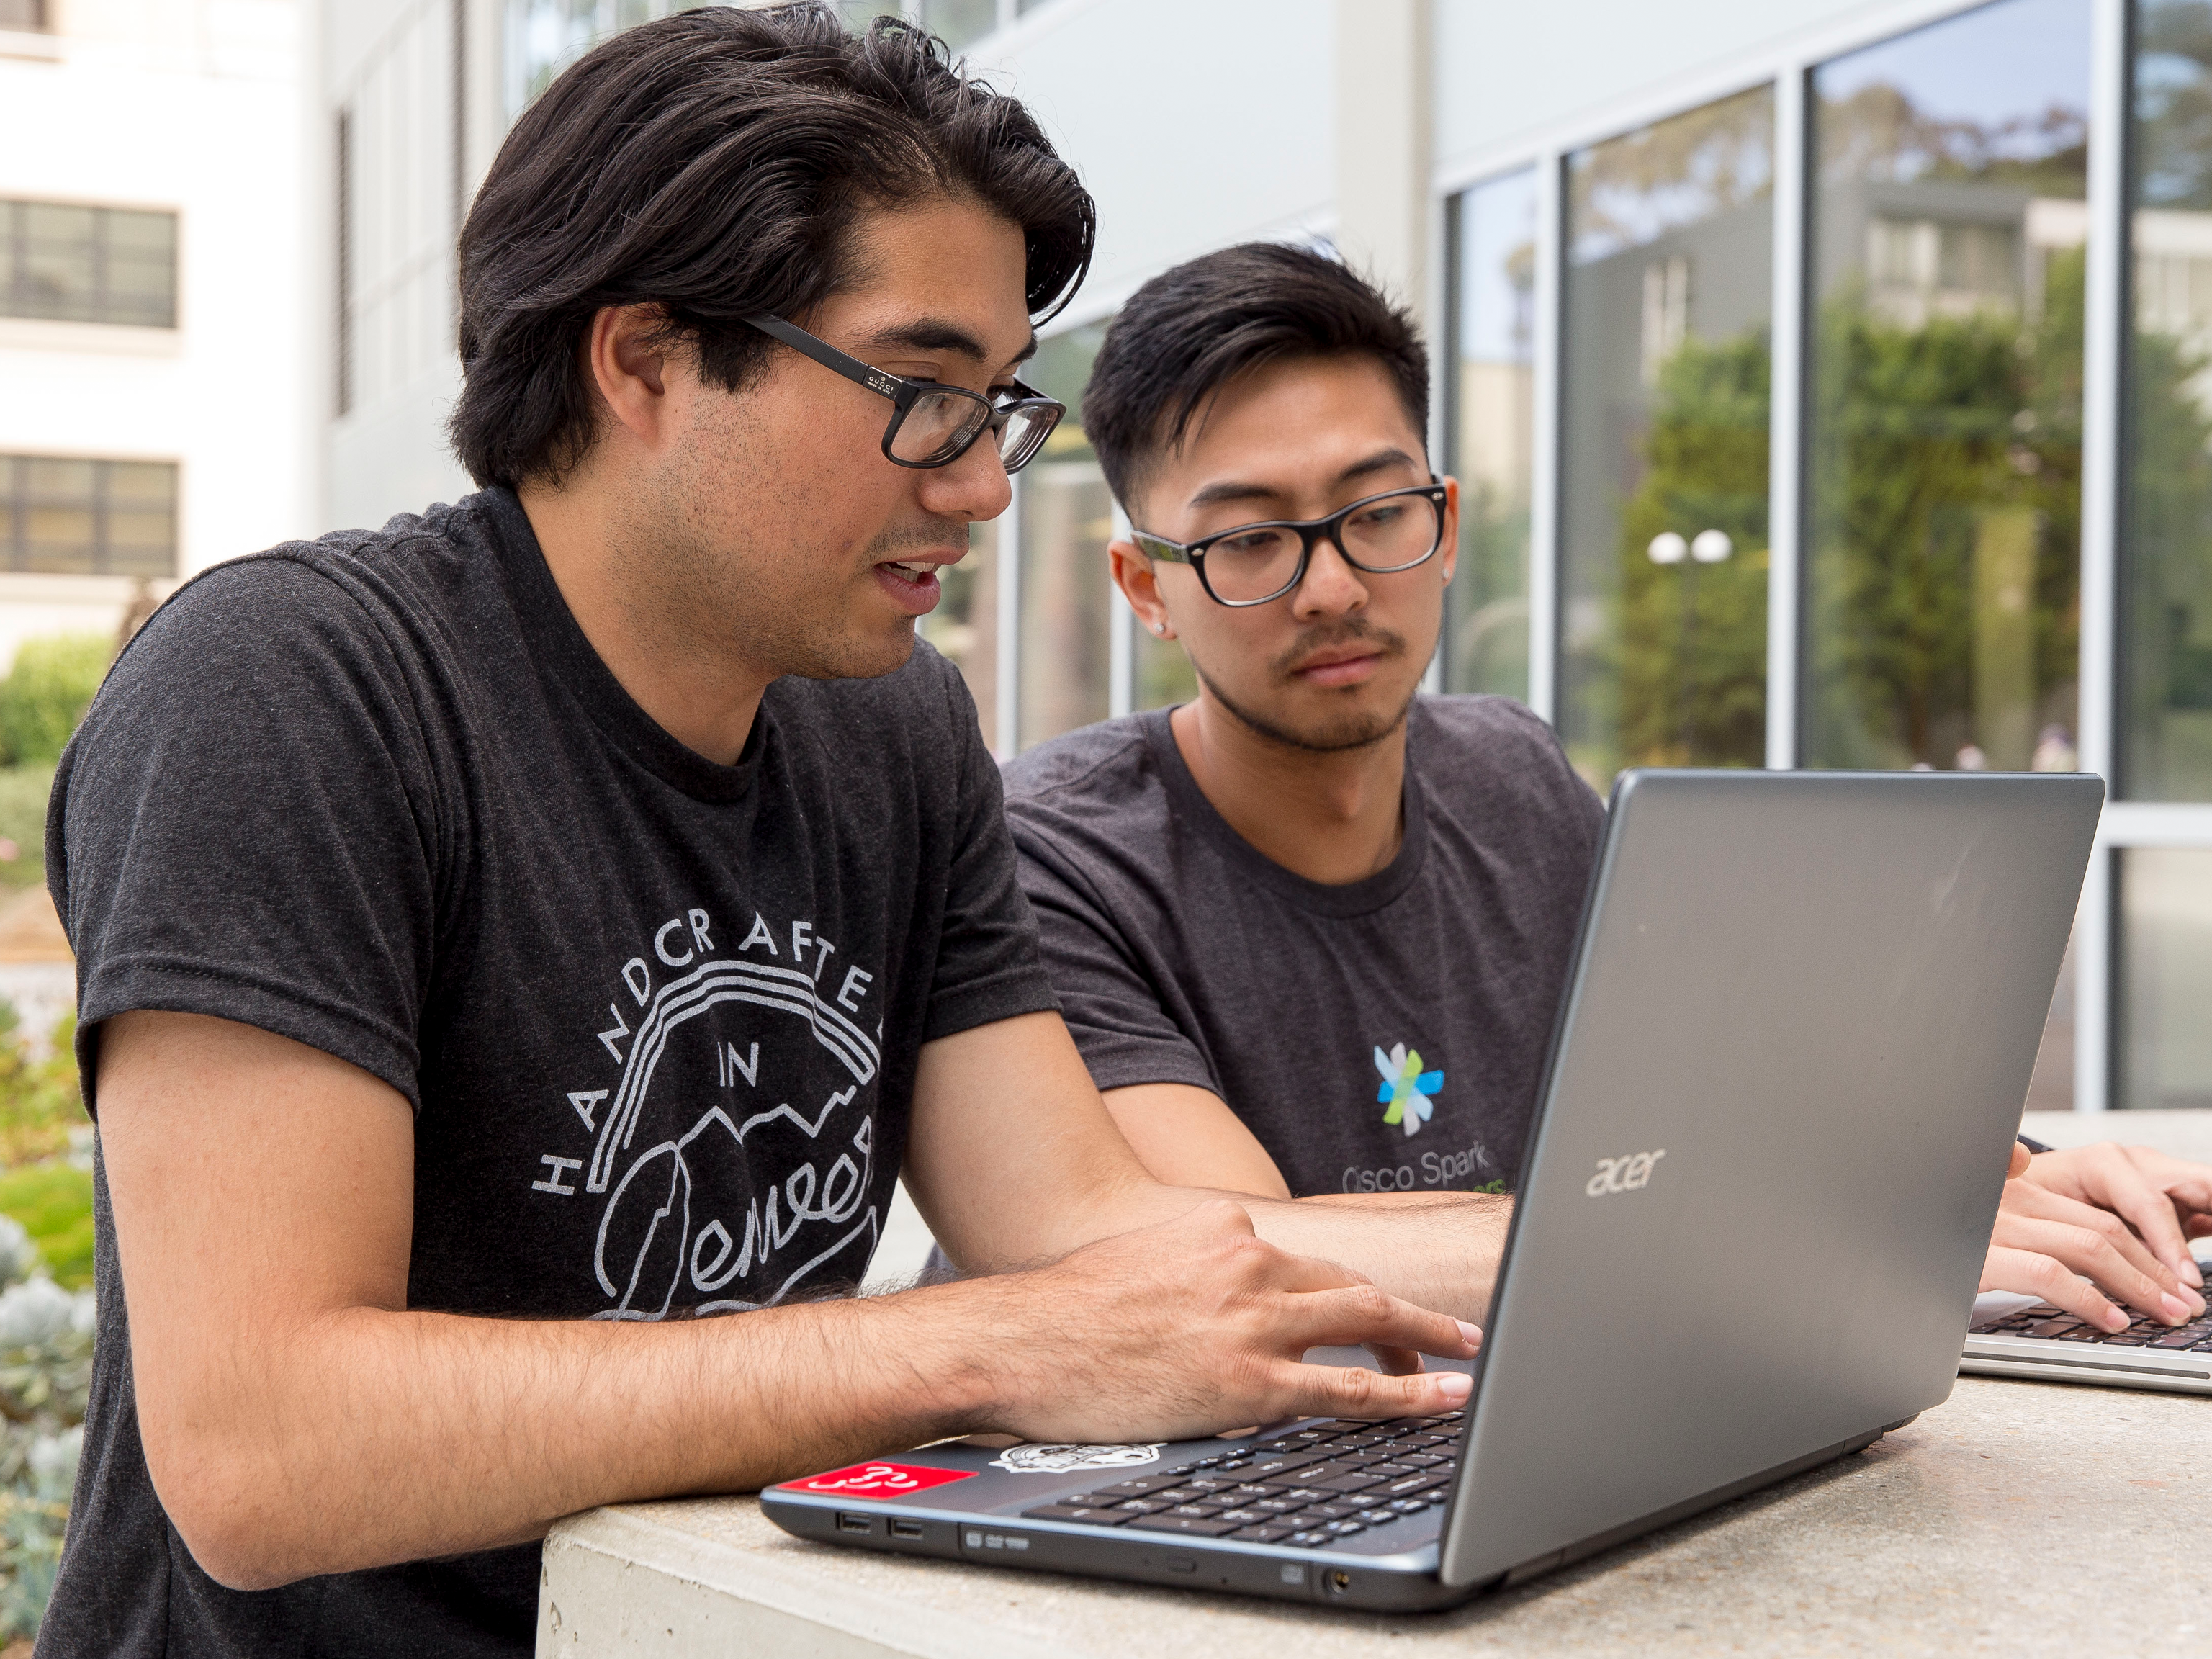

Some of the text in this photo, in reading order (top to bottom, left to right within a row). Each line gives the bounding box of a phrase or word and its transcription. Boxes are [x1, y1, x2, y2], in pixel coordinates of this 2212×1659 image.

[868, 376, 894, 392] GUCCI
[531, 909, 884, 1196] HANDCRAFTE
[717, 1041, 760, 1087] IN
[1342, 1165, 1415, 1194] Cisco
[1421, 1140, 1491, 1187] Spark
[1586, 1148, 1667, 1197] acer
